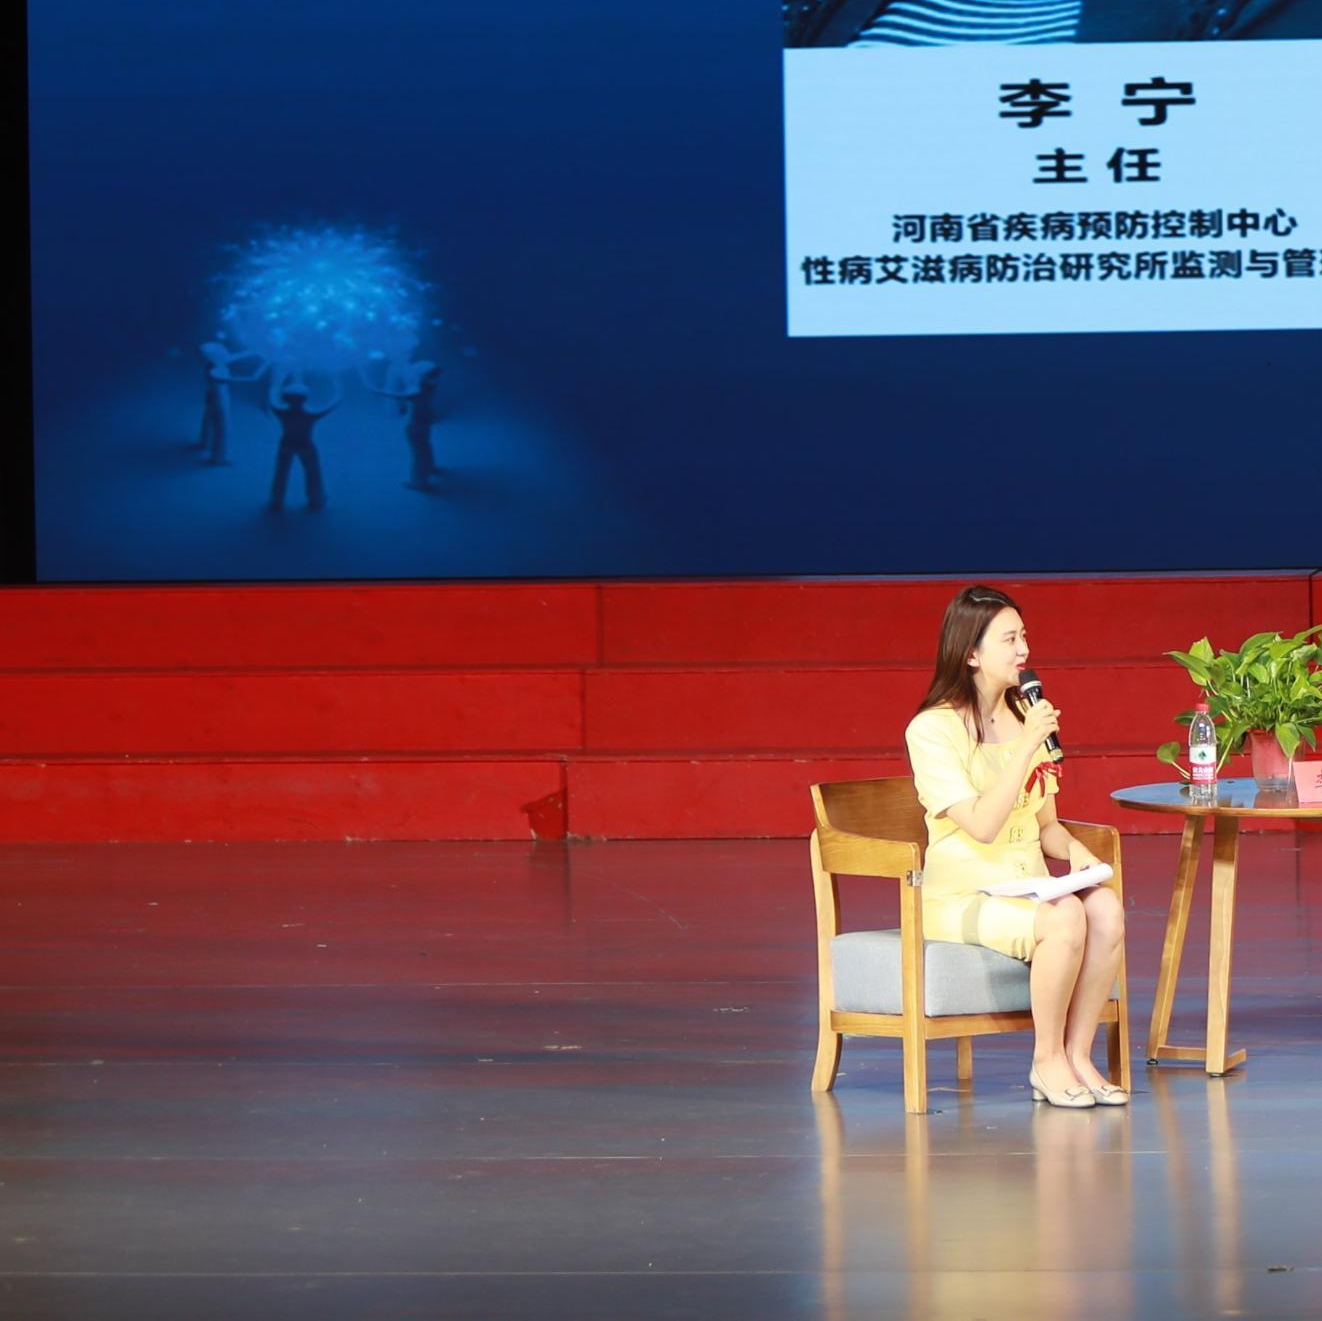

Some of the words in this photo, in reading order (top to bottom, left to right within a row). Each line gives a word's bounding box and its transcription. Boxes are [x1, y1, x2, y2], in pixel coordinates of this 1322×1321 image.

[998, 76, 1197, 129] 李宁
[1032, 147, 1161, 184] 主任
[892, 207, 1298, 245] 河南省疾病预防控制中心
